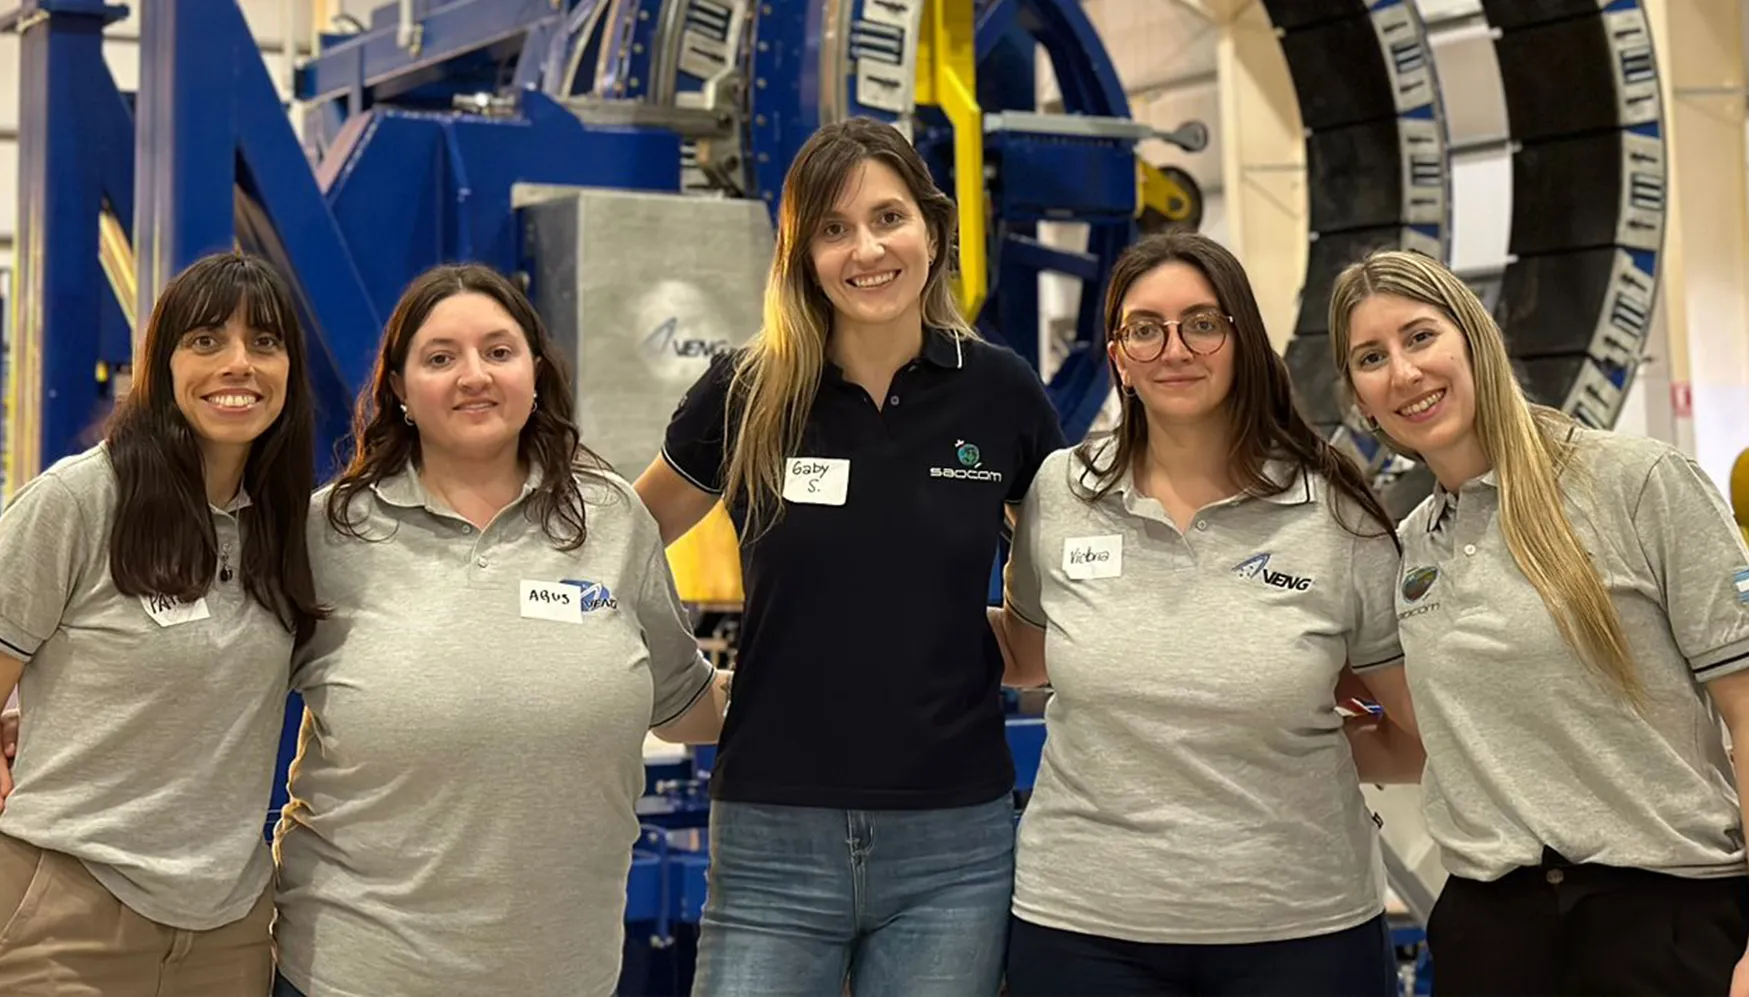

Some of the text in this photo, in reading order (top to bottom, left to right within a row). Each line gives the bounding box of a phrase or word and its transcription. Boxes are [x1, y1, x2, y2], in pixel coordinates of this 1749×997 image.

[792, 460, 830, 479] Gaby
[807, 478, 821, 493] S.
[1263, 568, 1312, 591] VENG
